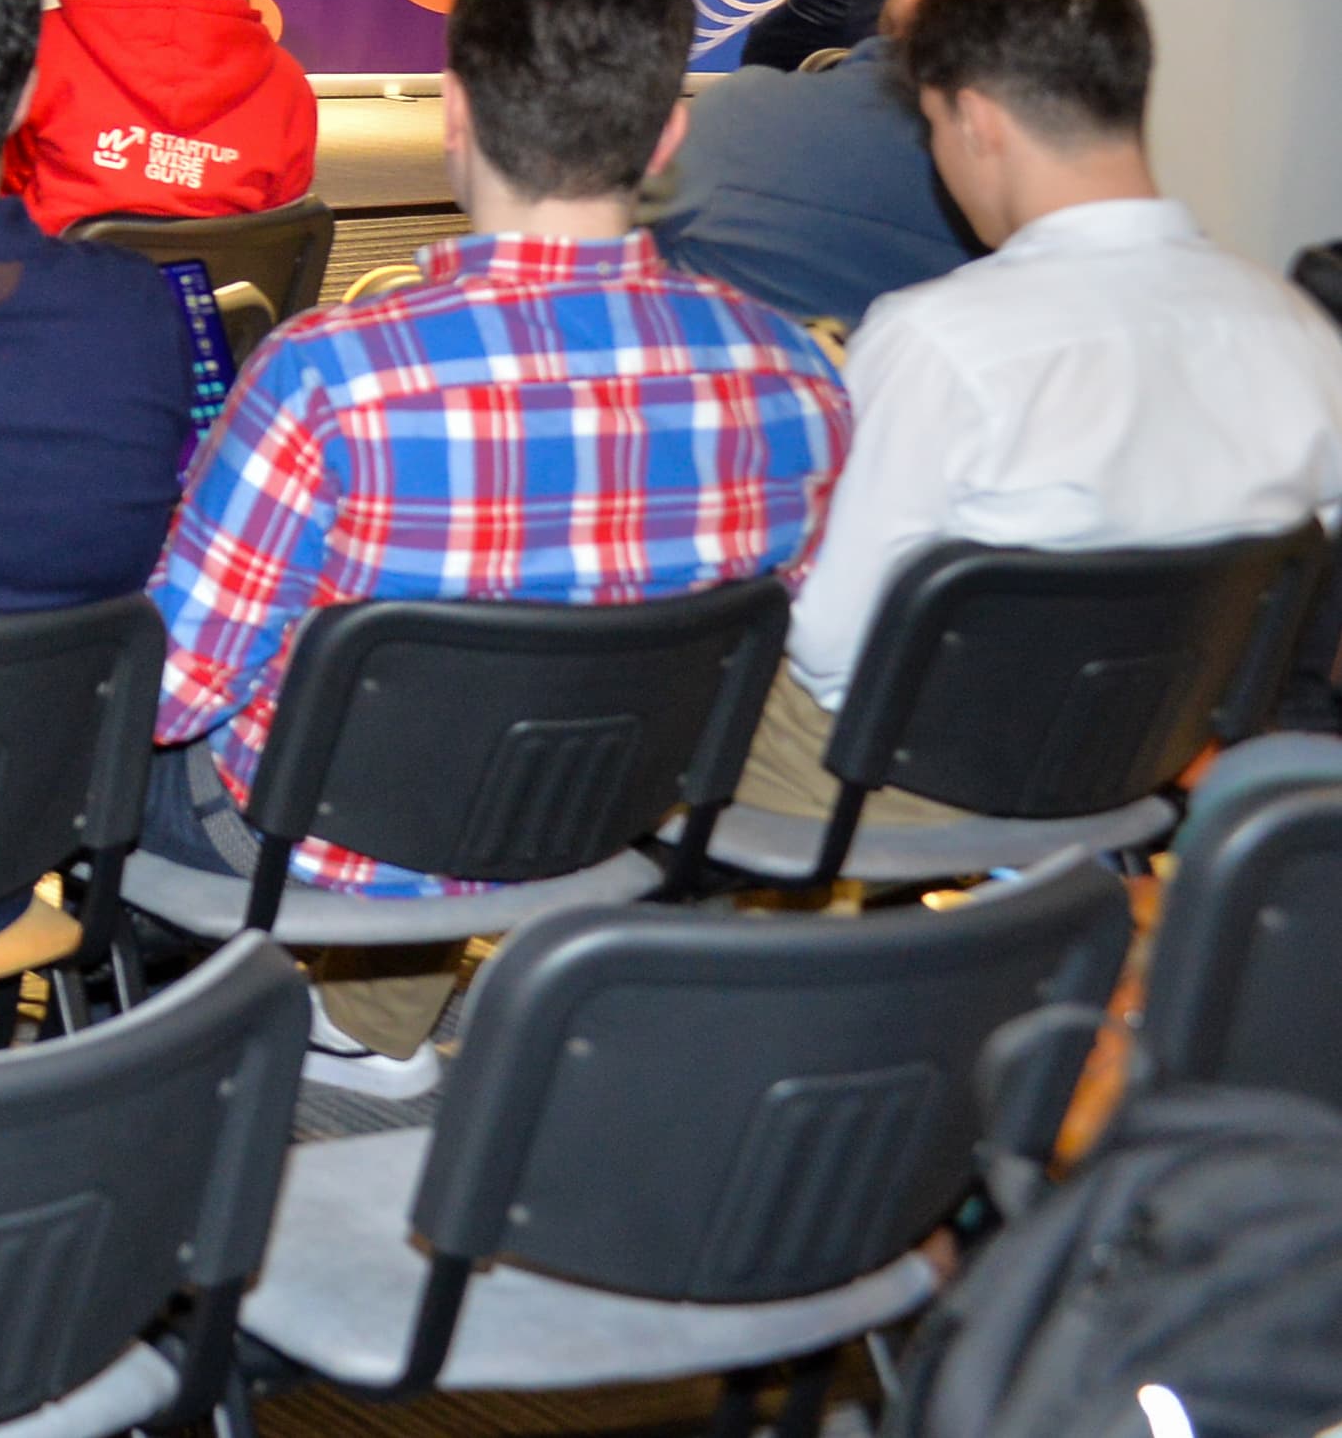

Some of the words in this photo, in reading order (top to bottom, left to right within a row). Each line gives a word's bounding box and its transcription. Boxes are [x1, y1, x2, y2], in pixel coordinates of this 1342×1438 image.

[147, 147, 204, 172] WISE
[149, 131, 240, 164] STARTUP
[144, 163, 202, 189] GUYS
